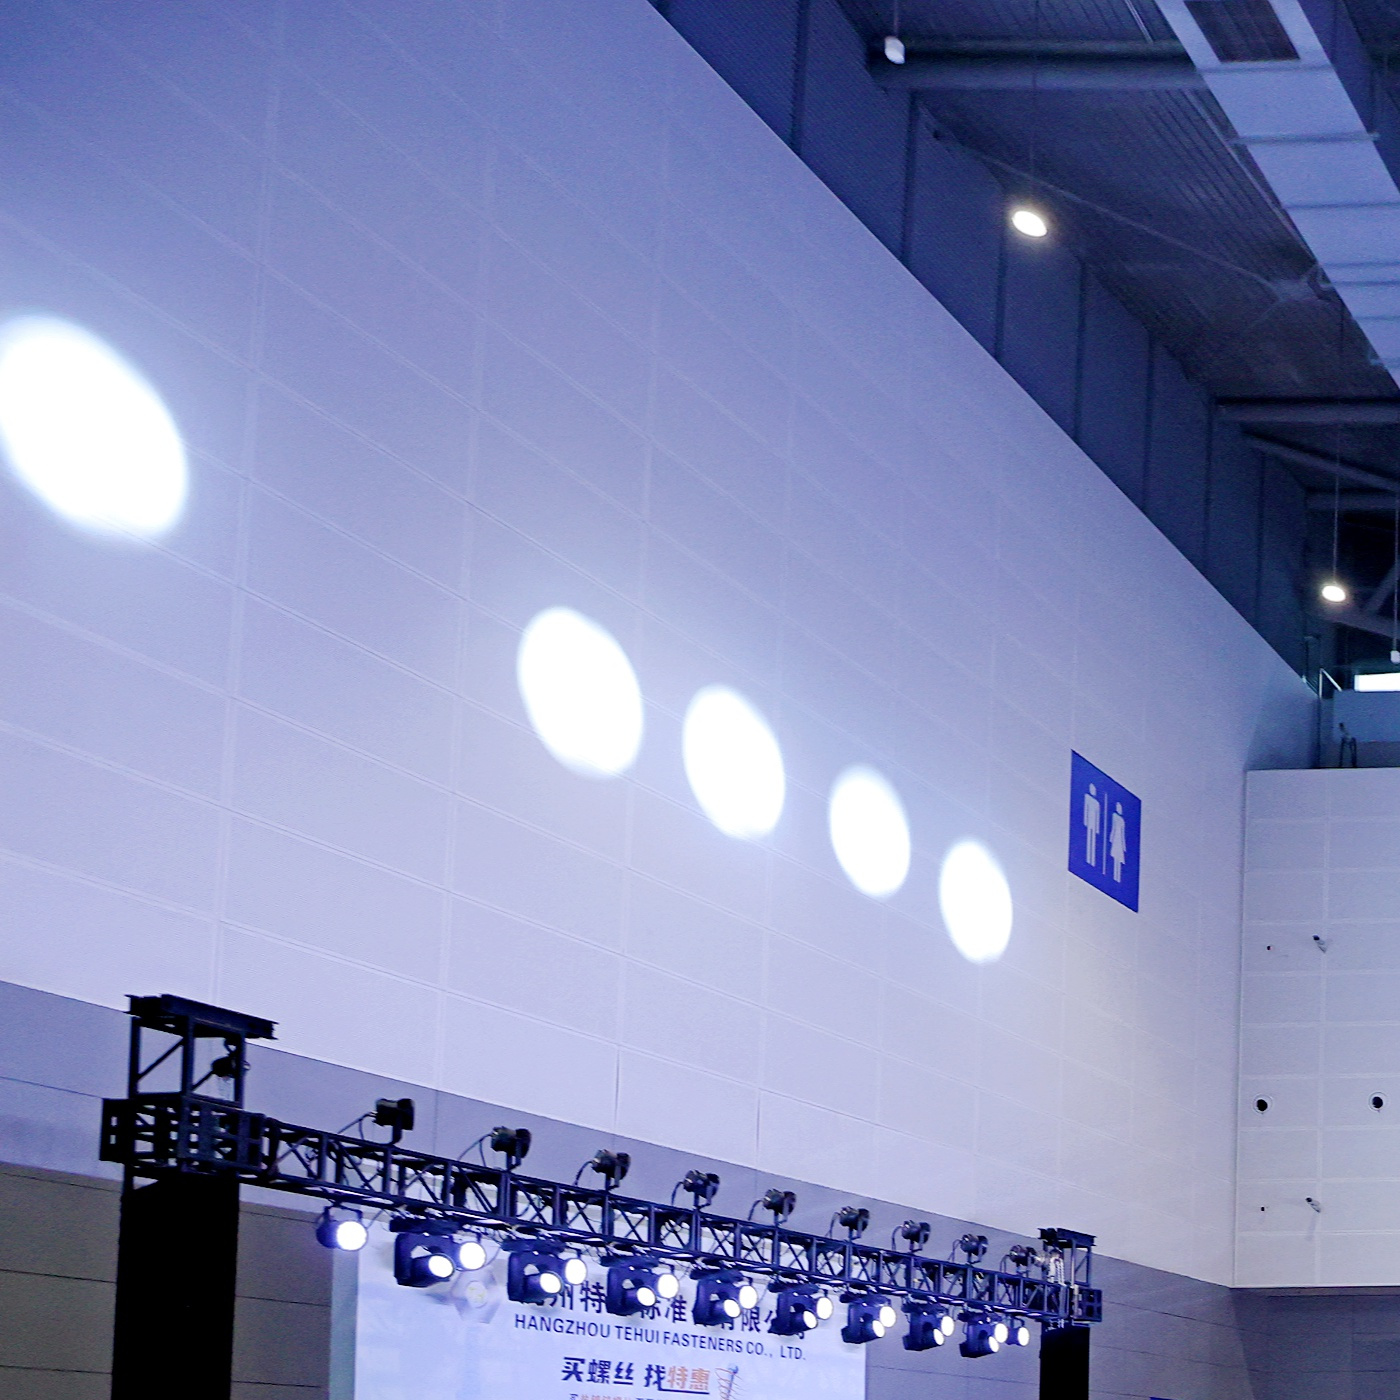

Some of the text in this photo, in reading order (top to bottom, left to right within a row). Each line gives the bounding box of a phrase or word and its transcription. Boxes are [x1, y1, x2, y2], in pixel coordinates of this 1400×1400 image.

[514, 1313, 611, 1338] HANGZHOU
[614, 1325, 660, 1343] TEHUI
[663, 1331, 743, 1354] FASTENERS
[780, 1345, 806, 1361] LTD.
[561, 1356, 711, 1394] 买螺丝 找特惠
